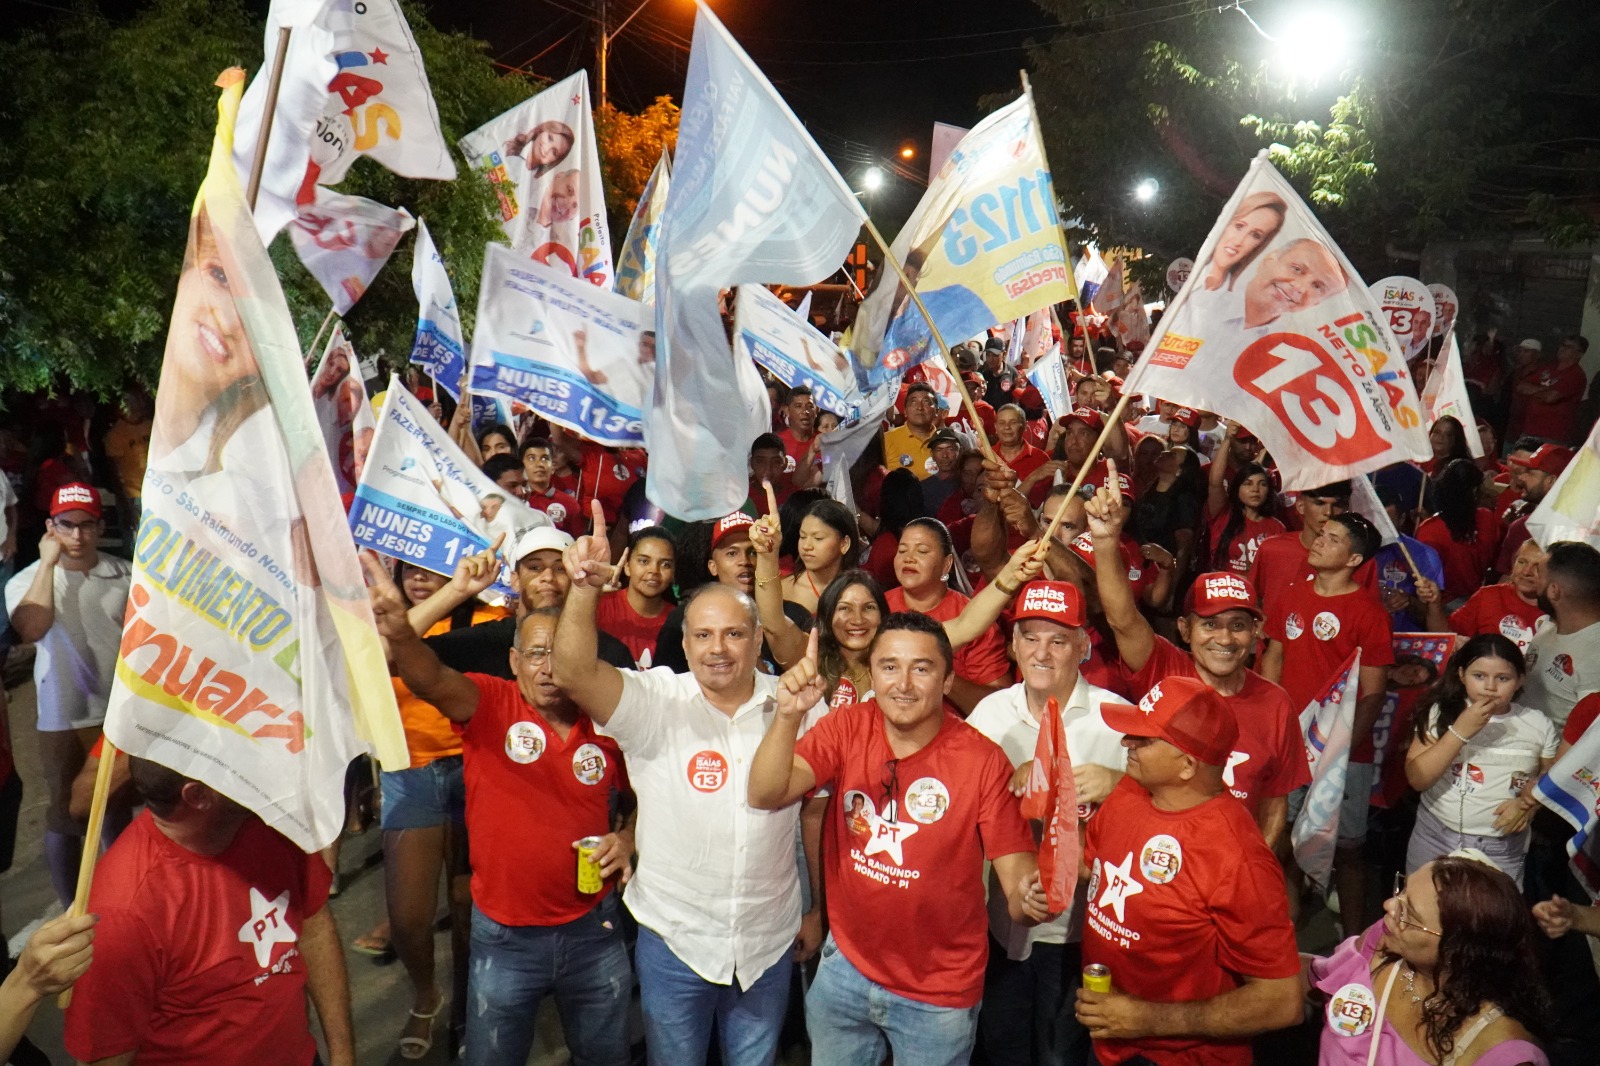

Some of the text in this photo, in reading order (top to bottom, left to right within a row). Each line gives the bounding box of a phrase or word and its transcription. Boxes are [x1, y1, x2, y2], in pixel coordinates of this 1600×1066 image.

[496, 366, 572, 399] NUNES
[1317, 324, 1366, 378] NETO
[1369, 396, 1392, 432] Alonso
[521, 391, 569, 414] JESUS
[1250, 342, 1357, 449] 13
[175, 491, 200, 517] São
[201, 510, 258, 558] Raimundo
[360, 503, 434, 543] NUNES
[396, 502, 428, 517] SEMPRE
[428, 513, 439, 521] AO
[440, 517, 457, 528] LADO
[353, 524, 427, 559] DE JESUS
[1026, 586, 1065, 600] Isaias
[1205, 575, 1245, 588] Isaias
[1206, 586, 1246, 600] Neto
[1023, 598, 1062, 613] Neto
[581, 757, 598, 771] 13
[697, 774, 718, 786] 13
[876, 824, 901, 843] PT
[850, 849, 920, 880] SÃO RAIMUNDO
[1152, 851, 1171, 867] 13
[854, 862, 890, 885] NONATO
[899, 879, 909, 889] PI
[1110, 874, 1128, 898] PT
[253, 907, 278, 942] PT
[1088, 916, 1113, 941] NONATO
[1120, 939, 1130, 949] PI
[1098, 911, 1140, 941] RAIMUNDO
[1344, 1002, 1364, 1018] 13
